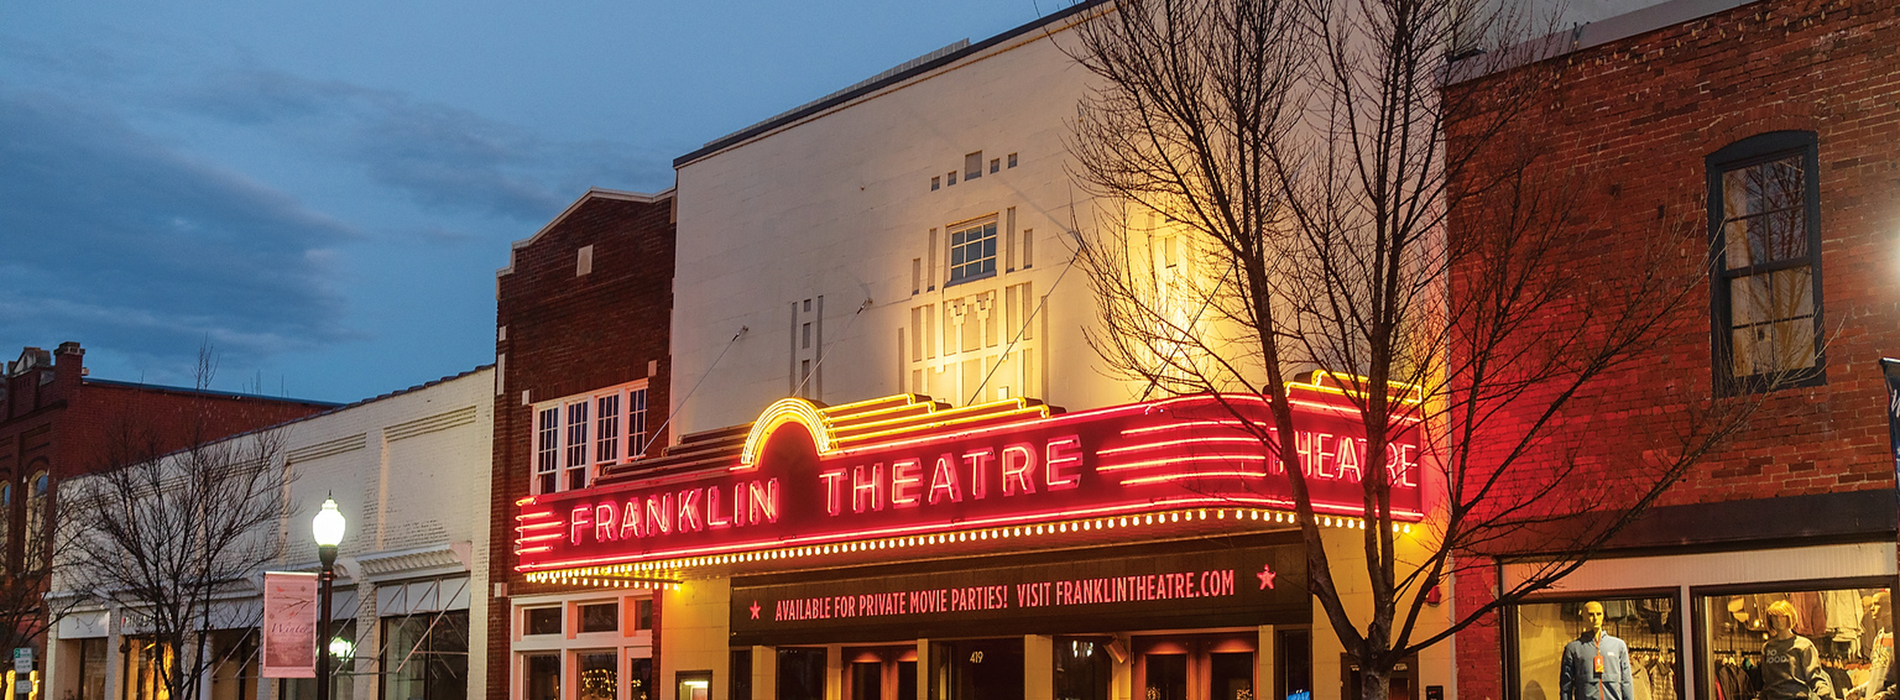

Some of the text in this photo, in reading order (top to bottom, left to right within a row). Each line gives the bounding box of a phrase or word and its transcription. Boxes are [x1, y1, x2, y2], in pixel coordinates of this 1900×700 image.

[570, 433, 1083, 545] FRANKLIN THEATRE
[775, 569, 1235, 621] AVAILABLE FOR PRIVATE MOVIE PARTIES! VISIT FRANKLINTHEATRE.COM
[271, 622, 309, 633] Winter
[969, 650, 984, 663] 419
